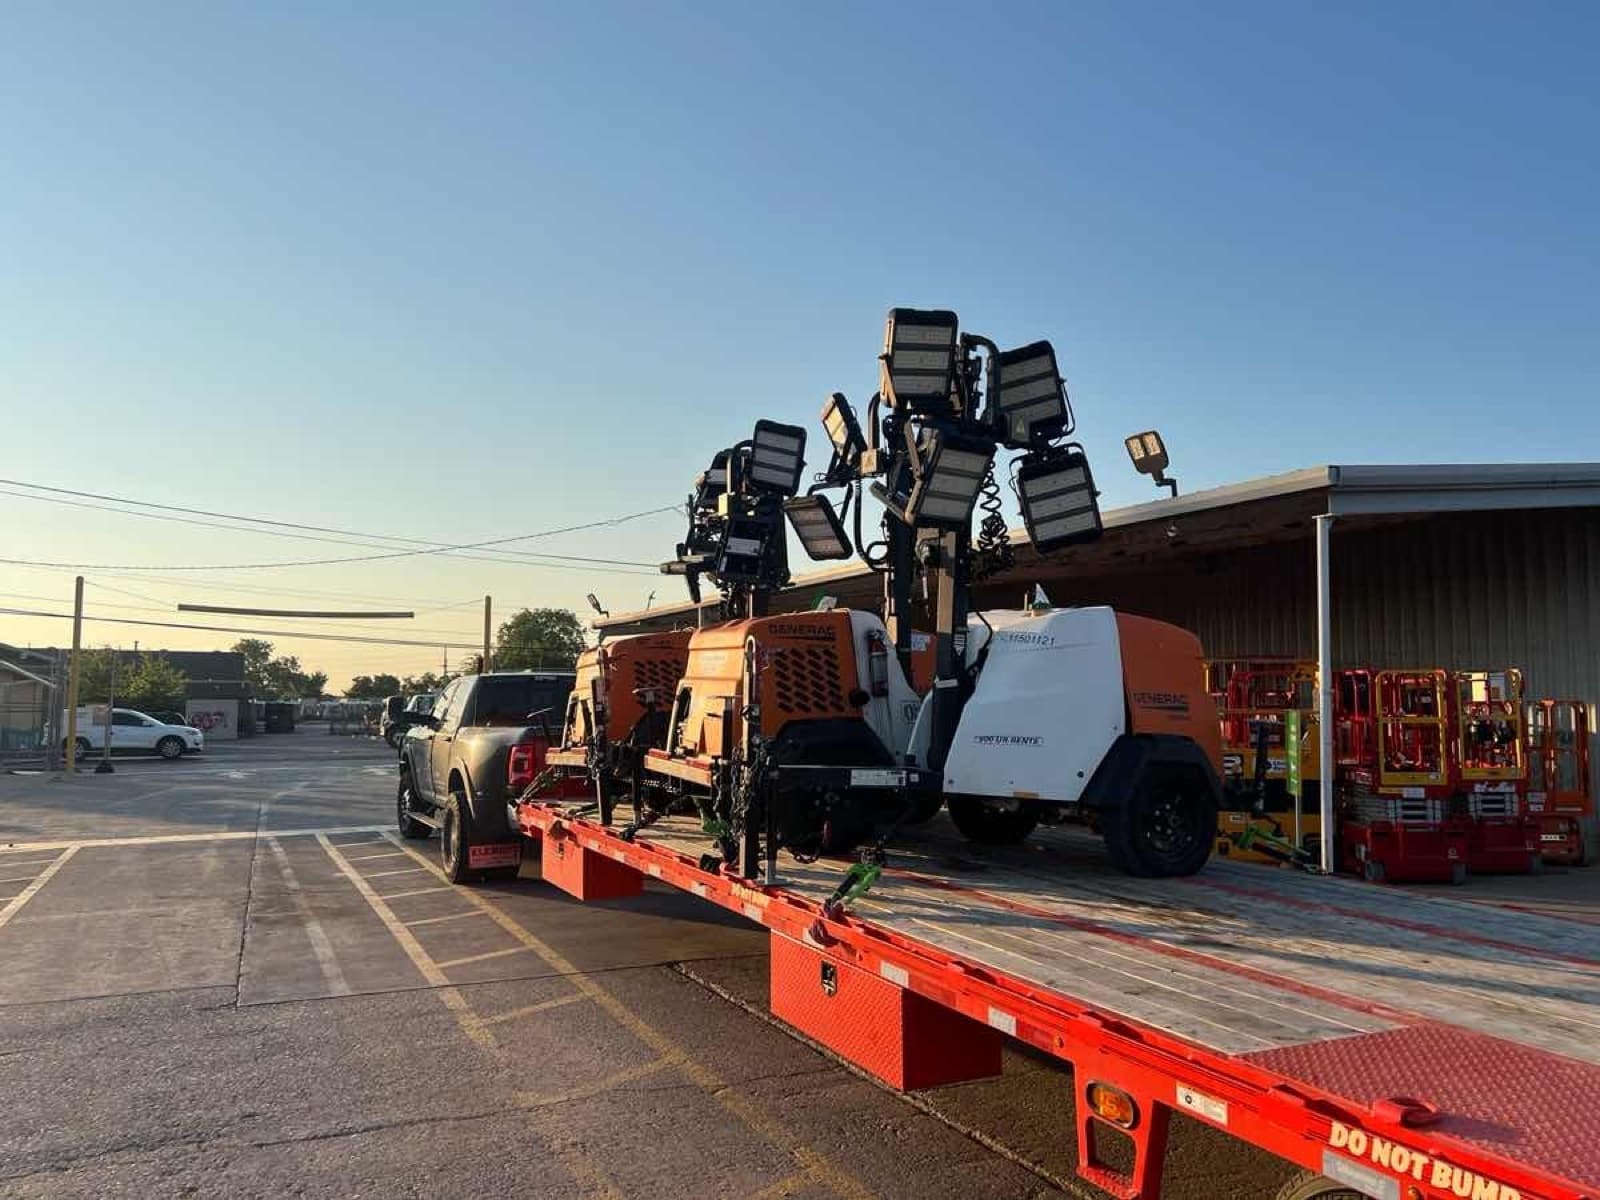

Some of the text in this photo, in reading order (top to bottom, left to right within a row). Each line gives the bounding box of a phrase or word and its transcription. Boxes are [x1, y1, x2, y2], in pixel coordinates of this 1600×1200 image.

[768, 624, 836, 637] GENERAC
[1133, 692, 1187, 705] GENERAC
[1329, 1120, 1367, 1156] DO
[1371, 1137, 1430, 1181] NOT
